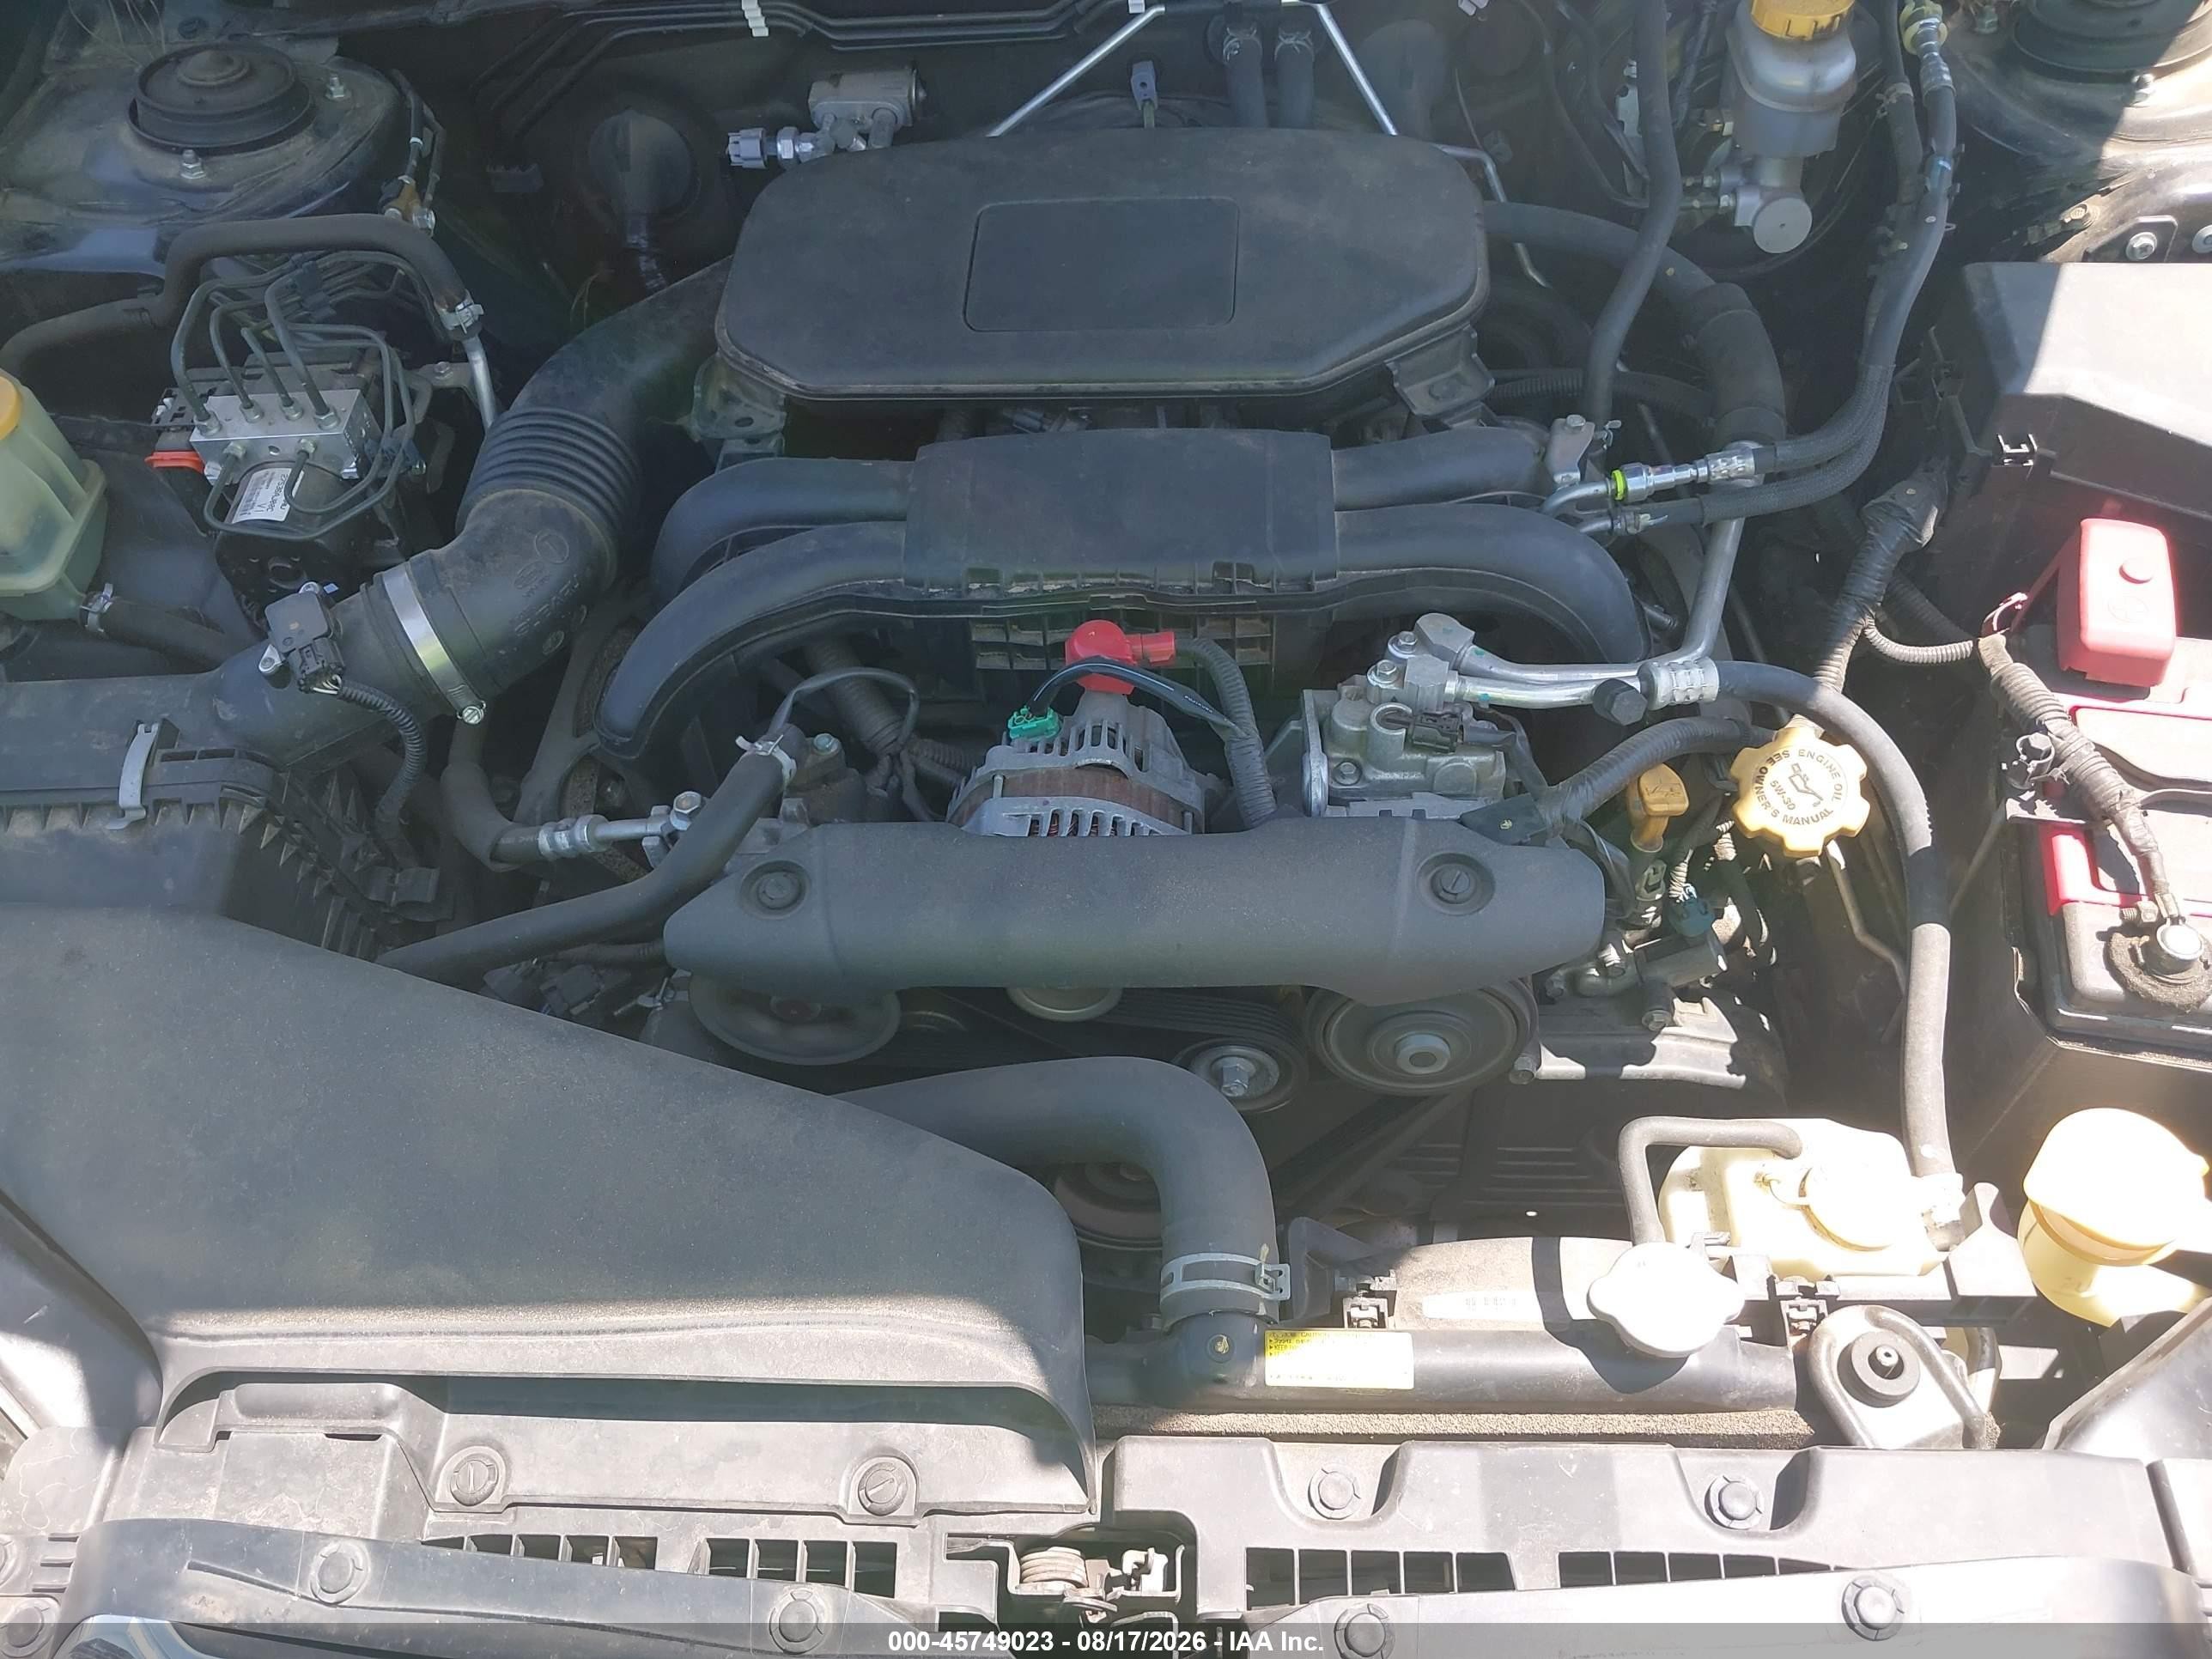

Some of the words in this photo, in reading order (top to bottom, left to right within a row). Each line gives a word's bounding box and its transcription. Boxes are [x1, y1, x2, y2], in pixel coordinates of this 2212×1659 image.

[1765, 750, 1790, 766] SEE
[1798, 749, 1841, 780] ENGINE
[1831, 783, 1843, 802] OIL
[1754, 766, 1780, 818] OWNER'S
[1770, 780, 1796, 811] 5W-30
[1782, 808, 1834, 825] MANUAL
